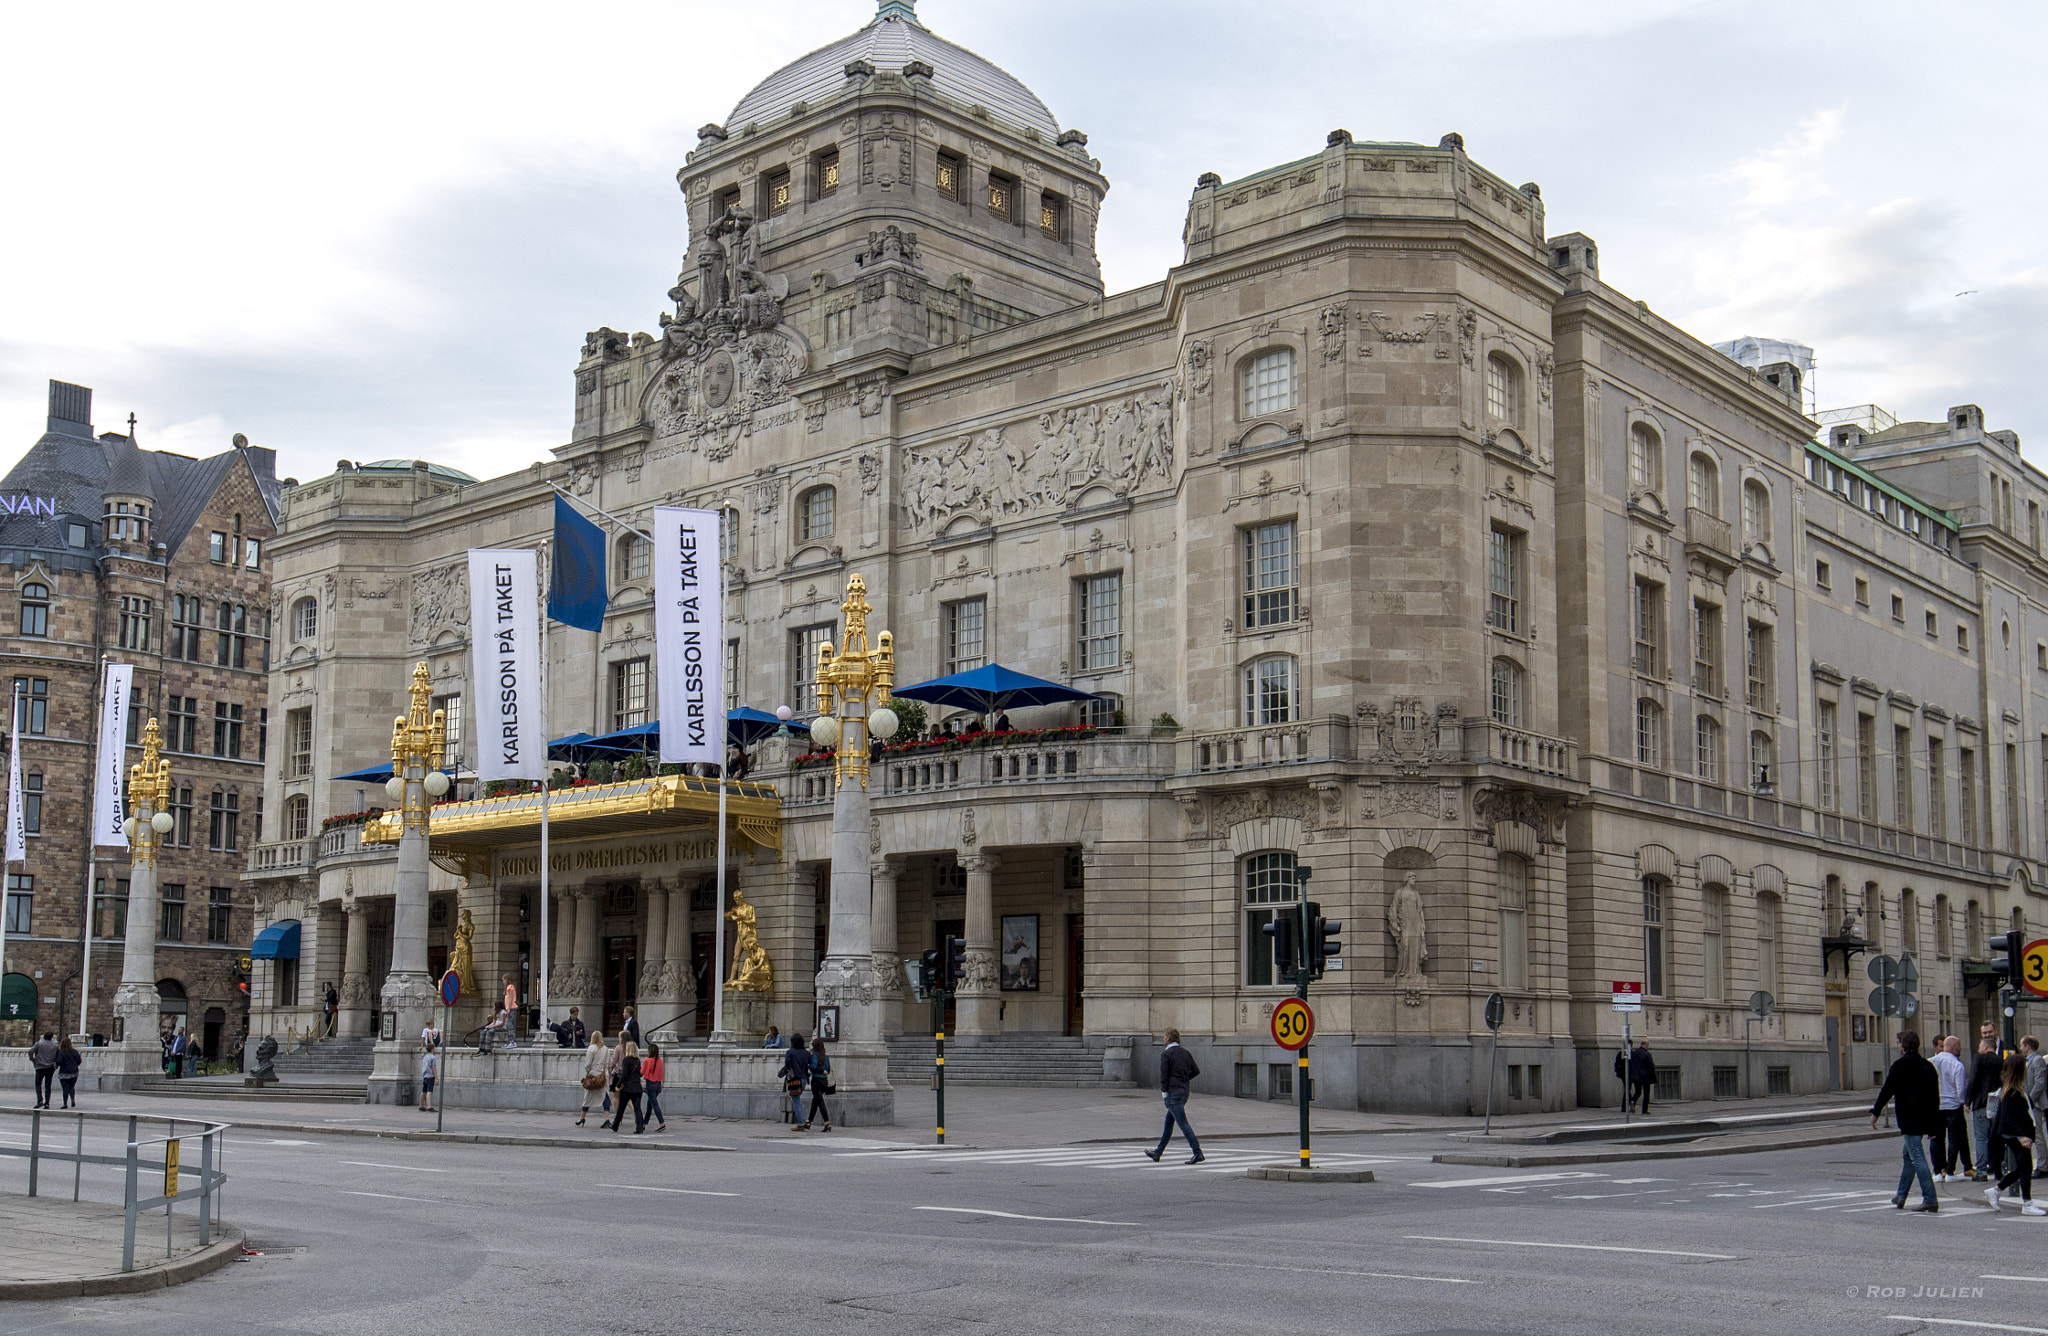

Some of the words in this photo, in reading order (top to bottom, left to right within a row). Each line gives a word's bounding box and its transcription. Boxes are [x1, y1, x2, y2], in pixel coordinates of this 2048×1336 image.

[680, 523, 699, 591] TAKET
[495, 564, 514, 624] TAKET
[677, 596, 699, 624] PÅ
[493, 628, 515, 654] PÅ
[684, 631, 706, 747] KARLSSON
[500, 660, 520, 765] KARLSSON
[500, 853, 571, 876] KUNGLGA
[575, 843, 668, 871] DRAMATISKA
[675, 839, 738, 861] TEATE
[2027, 954, 2048, 982] 3
[1279, 1011, 1307, 1038] 30
